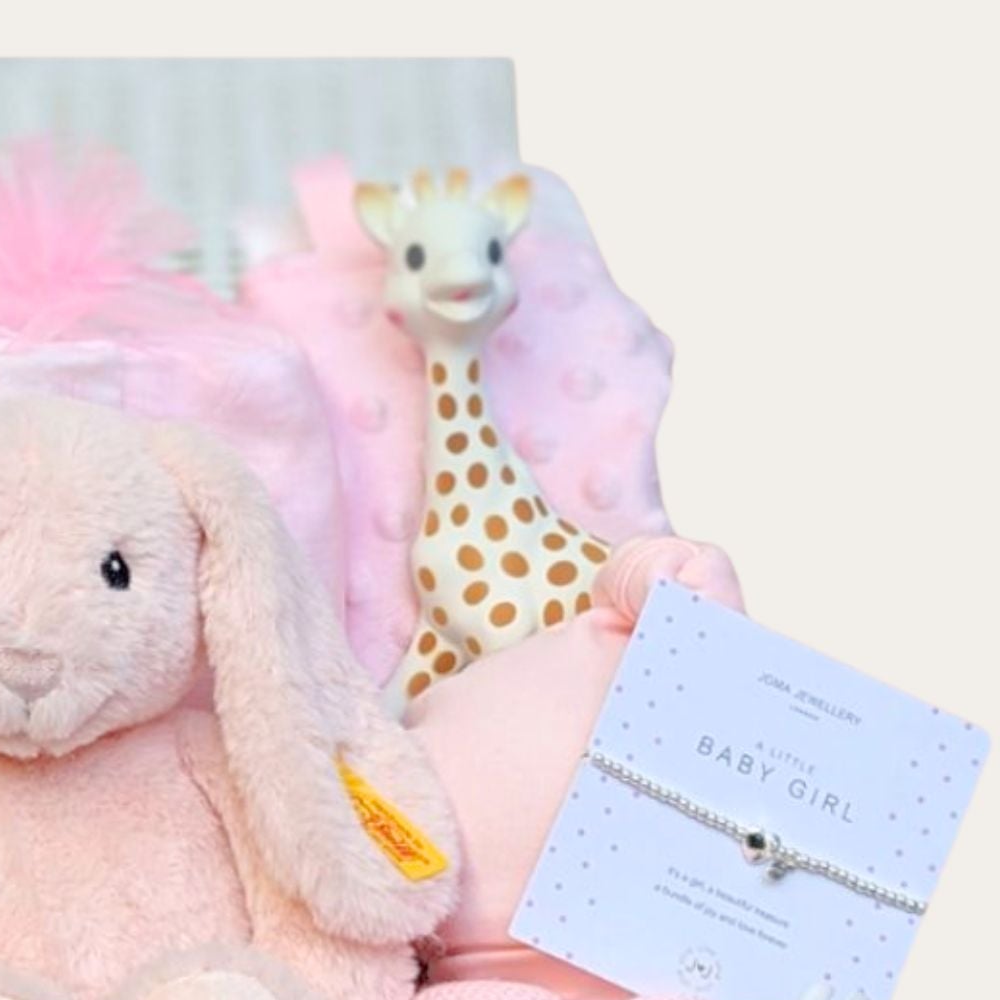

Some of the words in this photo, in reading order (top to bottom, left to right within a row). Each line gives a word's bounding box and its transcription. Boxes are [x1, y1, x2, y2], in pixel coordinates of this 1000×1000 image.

[793, 689, 862, 726] JEWELLERY
[696, 735, 775, 783] BABY
[788, 778, 853, 824] GIRL
[769, 747, 815, 776] LITTLE
